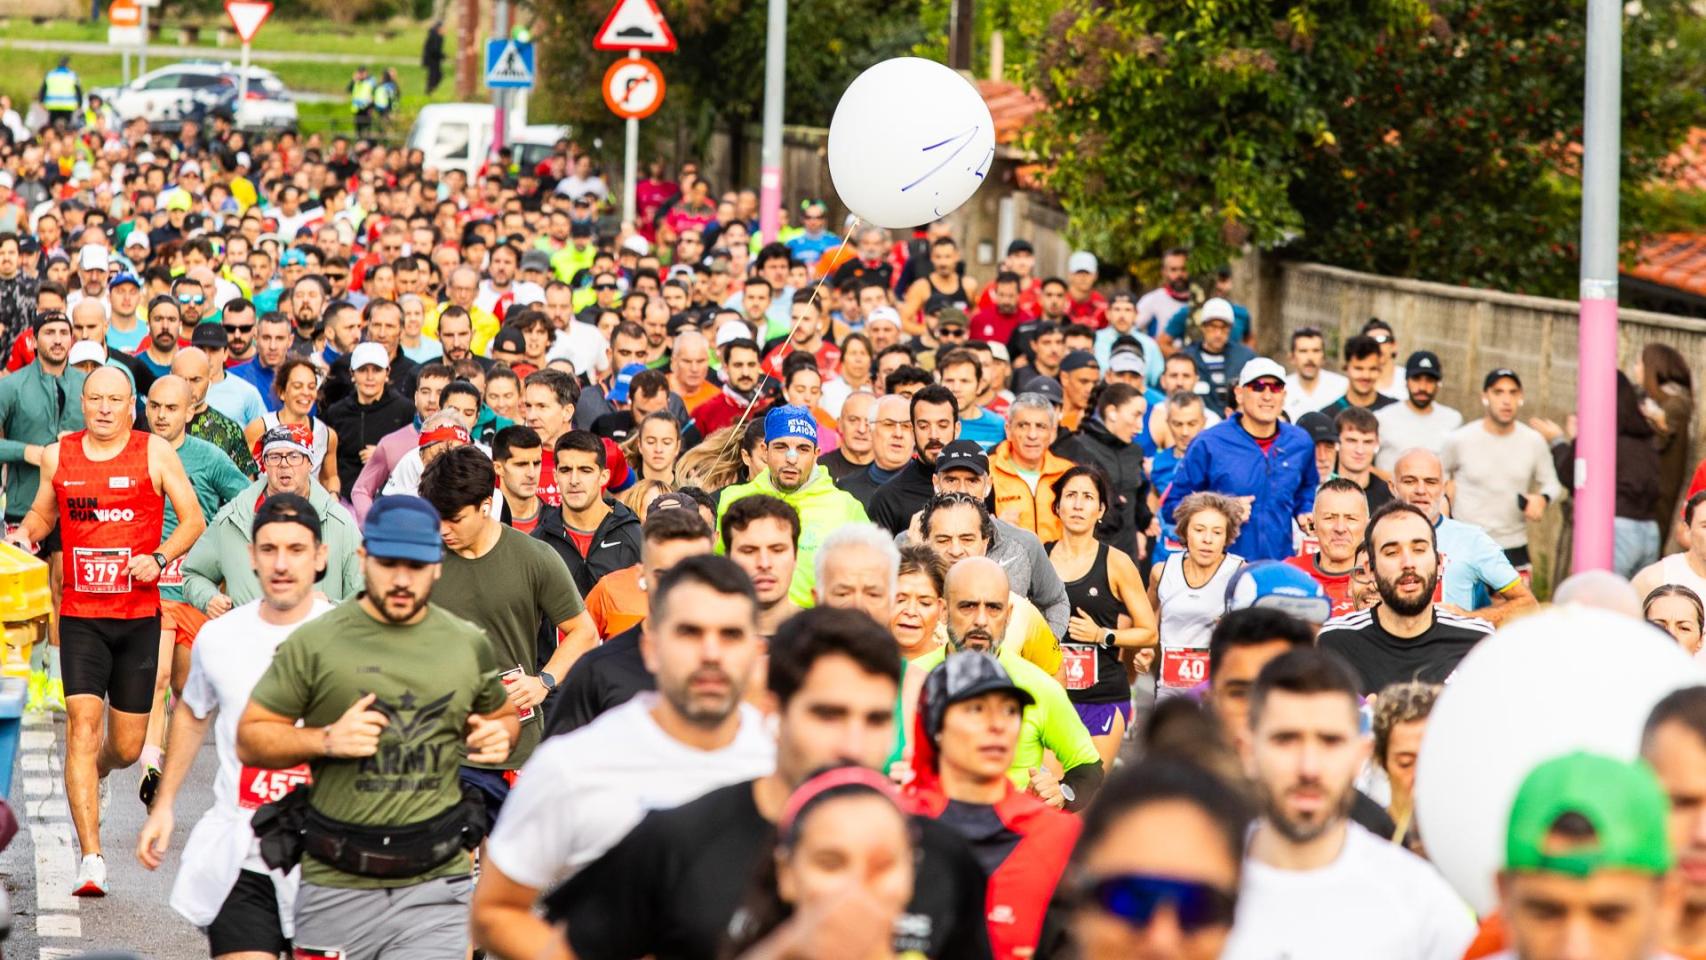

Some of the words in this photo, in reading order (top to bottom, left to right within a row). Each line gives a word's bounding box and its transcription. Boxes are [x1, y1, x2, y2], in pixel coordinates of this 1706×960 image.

[67, 496, 98, 509] RUN
[83, 563, 119, 583] 379
[1177, 658, 1205, 680] 40
[357, 742, 443, 774] ARMY
